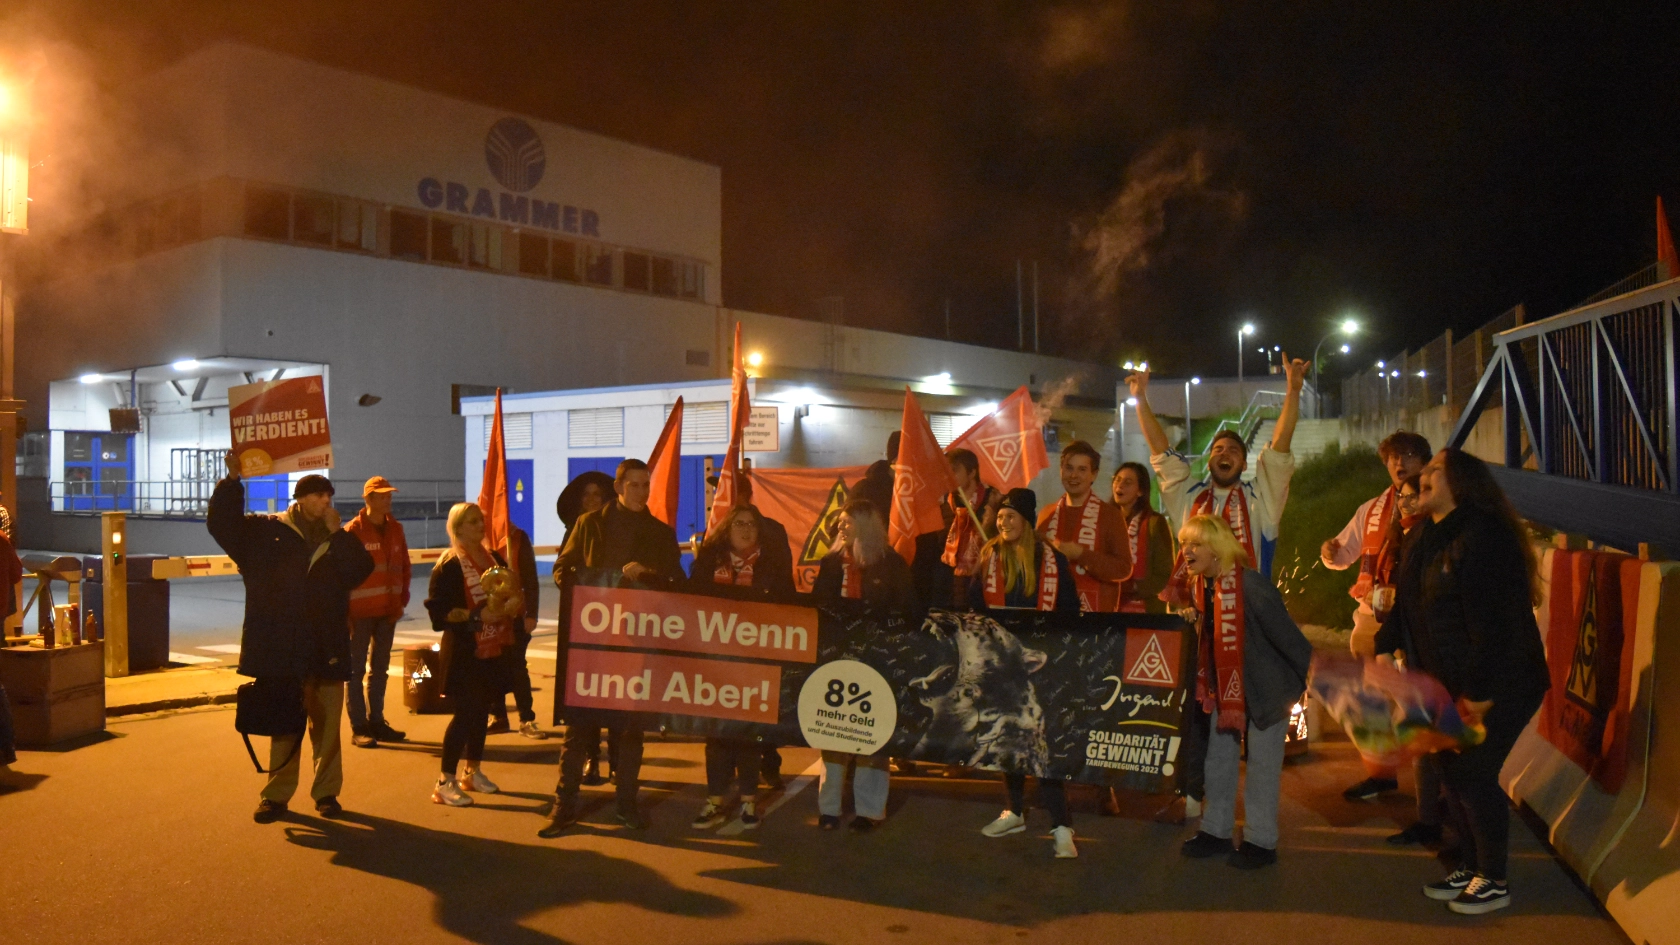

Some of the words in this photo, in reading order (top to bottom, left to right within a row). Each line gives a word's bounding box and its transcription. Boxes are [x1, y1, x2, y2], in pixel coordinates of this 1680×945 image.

[417, 177, 599, 237] GRAMMER
[233, 415, 253, 427] WIR
[256, 411, 292, 423] HABEN
[295, 409, 308, 419] ES
[234, 418, 326, 443] VERDIENT!
[580, 601, 686, 640] Ohne
[696, 610, 808, 651] Wenn
[575, 669, 652, 701] und
[661, 671, 770, 713] Aber!
[824, 679, 872, 714] 8%
[816, 708, 847, 721] mehr
[849, 713, 876, 727] Geld
[820, 730, 836, 738] dual
[836, 731, 877, 746] Studierende!
[825, 722, 873, 738] Auszubildende
[1088, 730, 1166, 750] SOLIDARITÄT
[1085, 758, 1139, 773] TARIFBEWEGUNG
[1141, 765, 1159, 774] 2022
